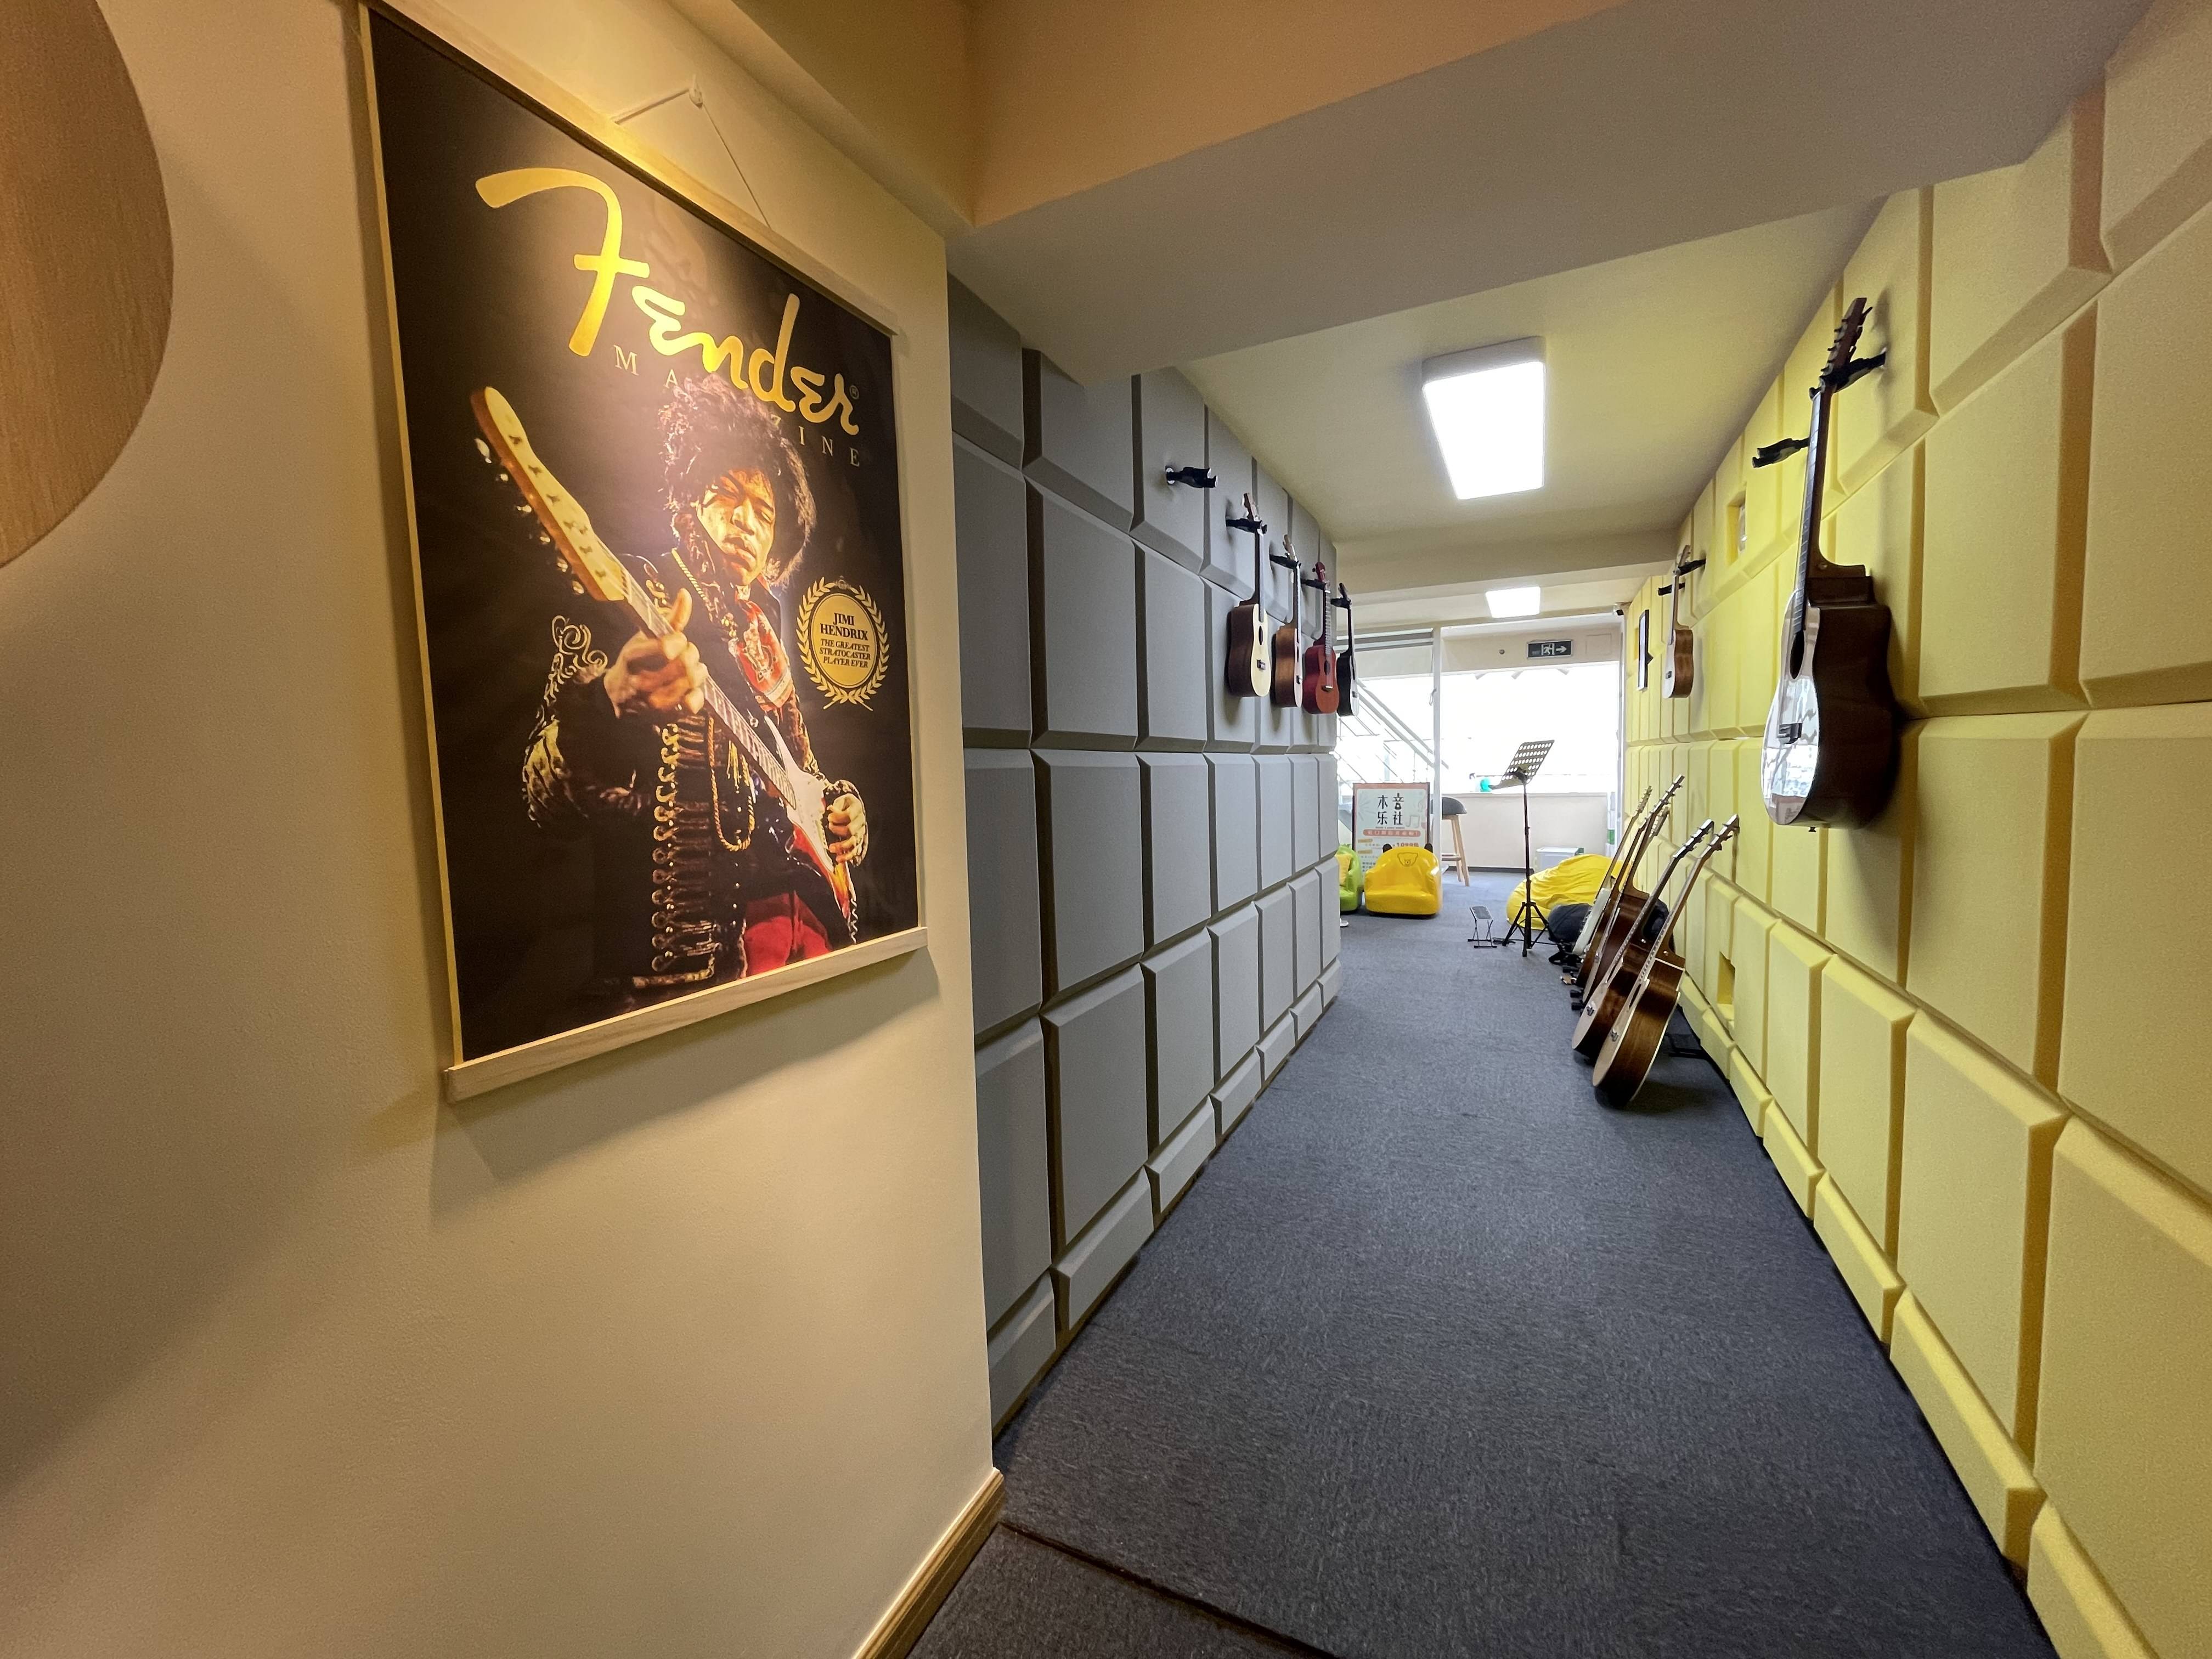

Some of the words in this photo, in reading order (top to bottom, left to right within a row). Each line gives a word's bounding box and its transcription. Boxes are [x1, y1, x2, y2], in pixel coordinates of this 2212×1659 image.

[475, 167, 859, 435] Fender
[613, 345, 860, 467] MAZINE
[833, 612, 855, 626] JIMI
[820, 623, 868, 641] HENDRIX
[821, 639, 834, 647] THE
[836, 640, 870, 652] GREATEST
[820, 647, 871, 660] STRATOCASTER
[823, 656, 850, 666] PLAYER
[850, 659, 868, 668] EVER
